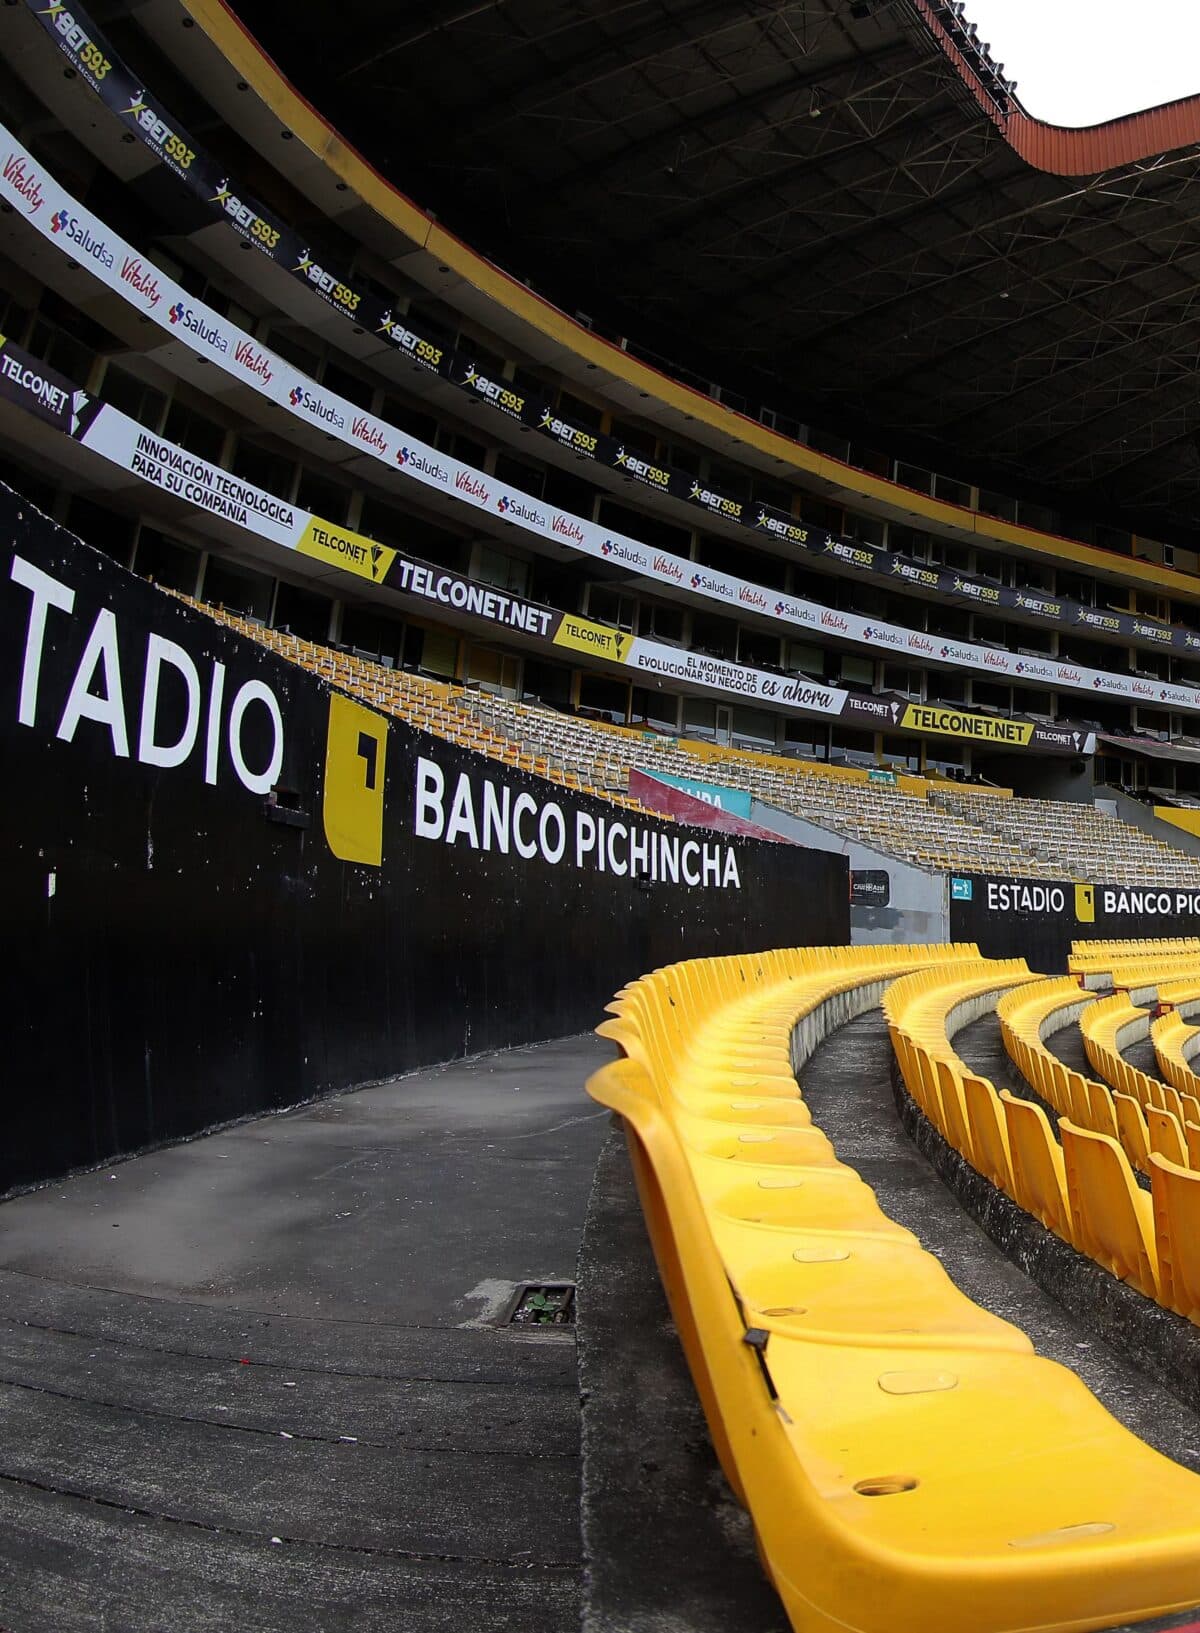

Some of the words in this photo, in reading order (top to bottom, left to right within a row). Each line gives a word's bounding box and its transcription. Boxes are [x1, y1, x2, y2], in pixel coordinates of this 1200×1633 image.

[2, 152, 45, 214] Vitality
[66, 218, 114, 270] Saludsa
[121, 256, 162, 308] Vitality
[183, 310, 228, 352] Saludsa
[234, 339, 275, 386] Vitality
[1, 353, 70, 410] TELCONET
[302, 392, 345, 430] Saludsa
[352, 417, 389, 455] Vitality
[131, 453, 162, 485] PARA
[165, 473, 183, 493] SU
[137, 433, 214, 486] INNOVACIÓN
[216, 475, 294, 527] TECNOLÓGICA
[409, 453, 448, 483] Saludsa
[454, 469, 491, 505] Vitality
[509, 500, 546, 527] Saludsa
[551, 514, 586, 546] Vitality
[313, 527, 368, 563] TELCONET
[612, 542, 647, 566] Saludsa
[653, 554, 684, 584] Vitality
[399, 559, 552, 636] TELCONET.NET
[701, 575, 734, 598] Saludsa
[739, 586, 769, 612] Vitality
[566, 623, 612, 649] TELCONET
[784, 602, 816, 623] Saludsa
[820, 610, 849, 633] Vitality
[872, 627, 903, 645] Saludsa
[907, 633, 935, 656] Vitality
[949, 646, 979, 663] Saludsa
[983, 651, 1010, 672] Vitality
[638, 655, 702, 681] EVOLUCIONAR
[705, 672, 716, 684] SU
[718, 676, 757, 694] NEGOCIO
[686, 656, 698, 669] EL
[699, 660, 744, 681] MOMENTO
[746, 672, 758, 684] DE
[762, 679, 782, 697] es
[782, 679, 834, 708] ahora
[849, 698, 889, 715] TELCONET
[10, 554, 284, 795] TADIO
[415, 756, 566, 864] BANCO
[576, 810, 742, 890] PICHINCHA
[912, 708, 1025, 742] TELCONET.NET
[1035, 730, 1072, 744] TELCONET
[988, 883, 1064, 913] ESTADIO
[1104, 891, 1171, 916] BANCO
